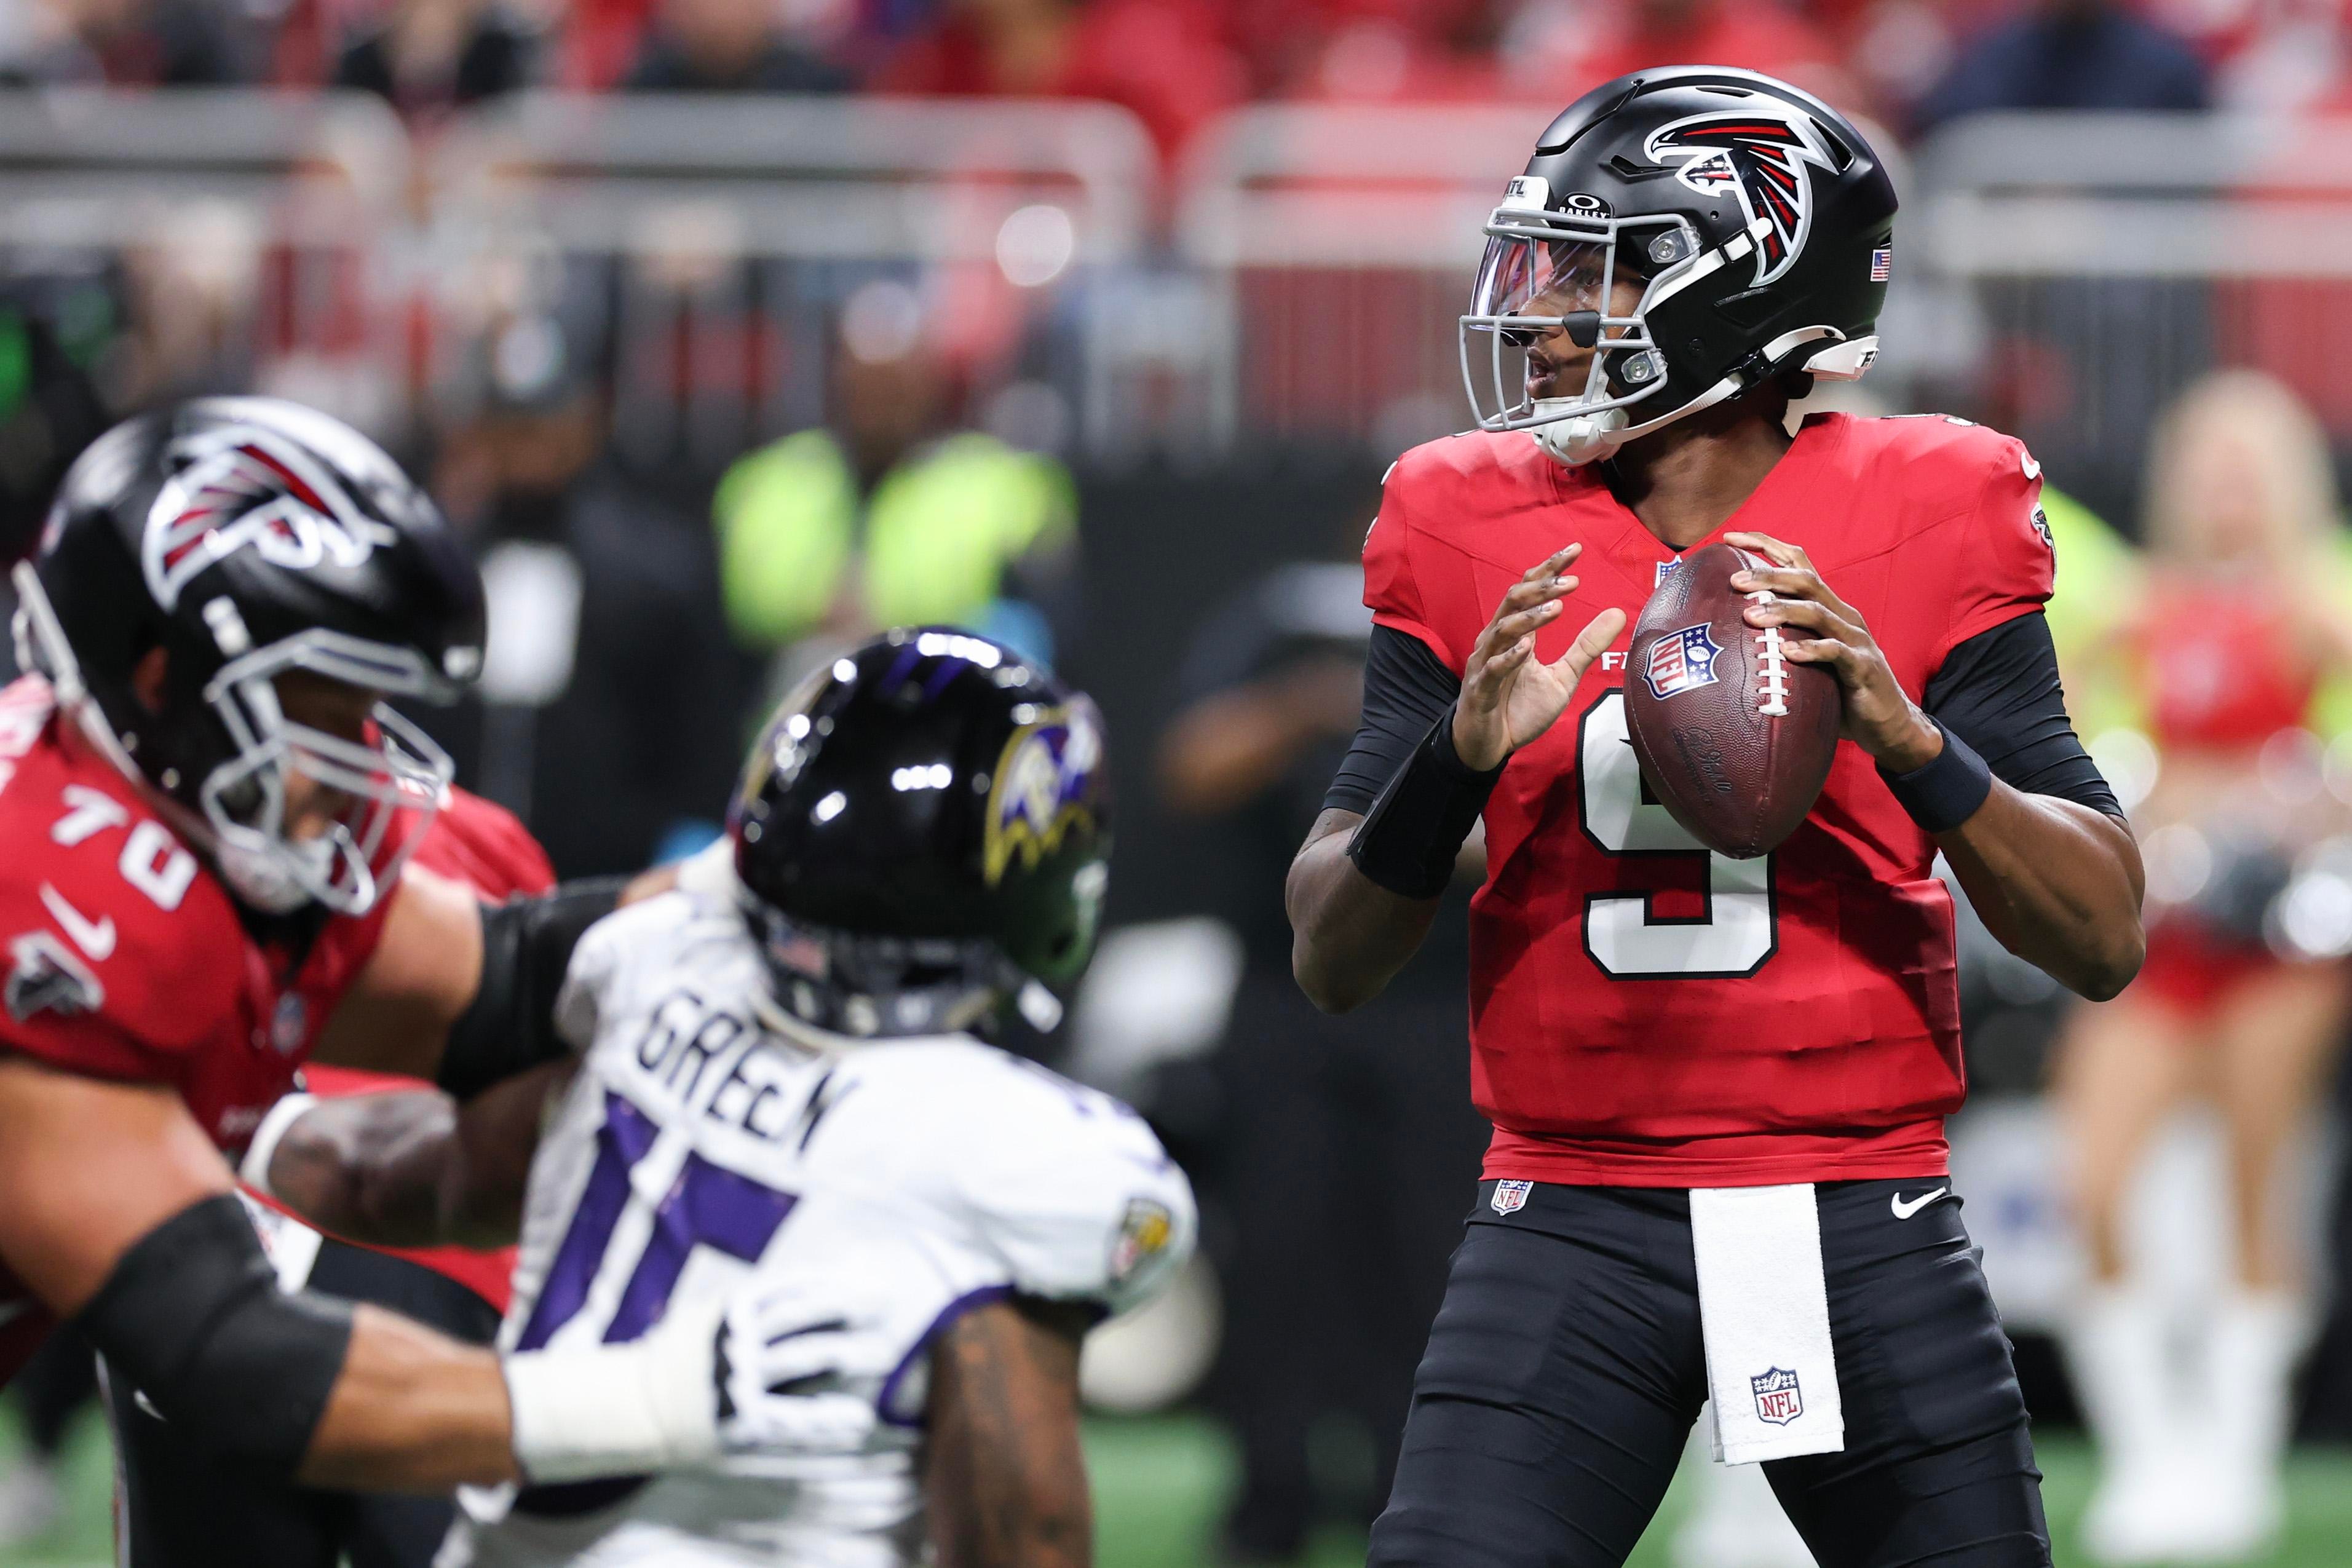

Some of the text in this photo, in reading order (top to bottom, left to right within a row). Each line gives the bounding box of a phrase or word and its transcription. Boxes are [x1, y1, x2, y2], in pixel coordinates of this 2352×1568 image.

[1559, 207, 1607, 219] OAKLEY
[1651, 637, 1685, 693] NFL
[1575, 687, 1779, 981] 9
[636, 987, 863, 1157] GREEN
[1497, 1190, 1521, 1208] NFL
[1760, 1392, 1798, 1417] NFL
